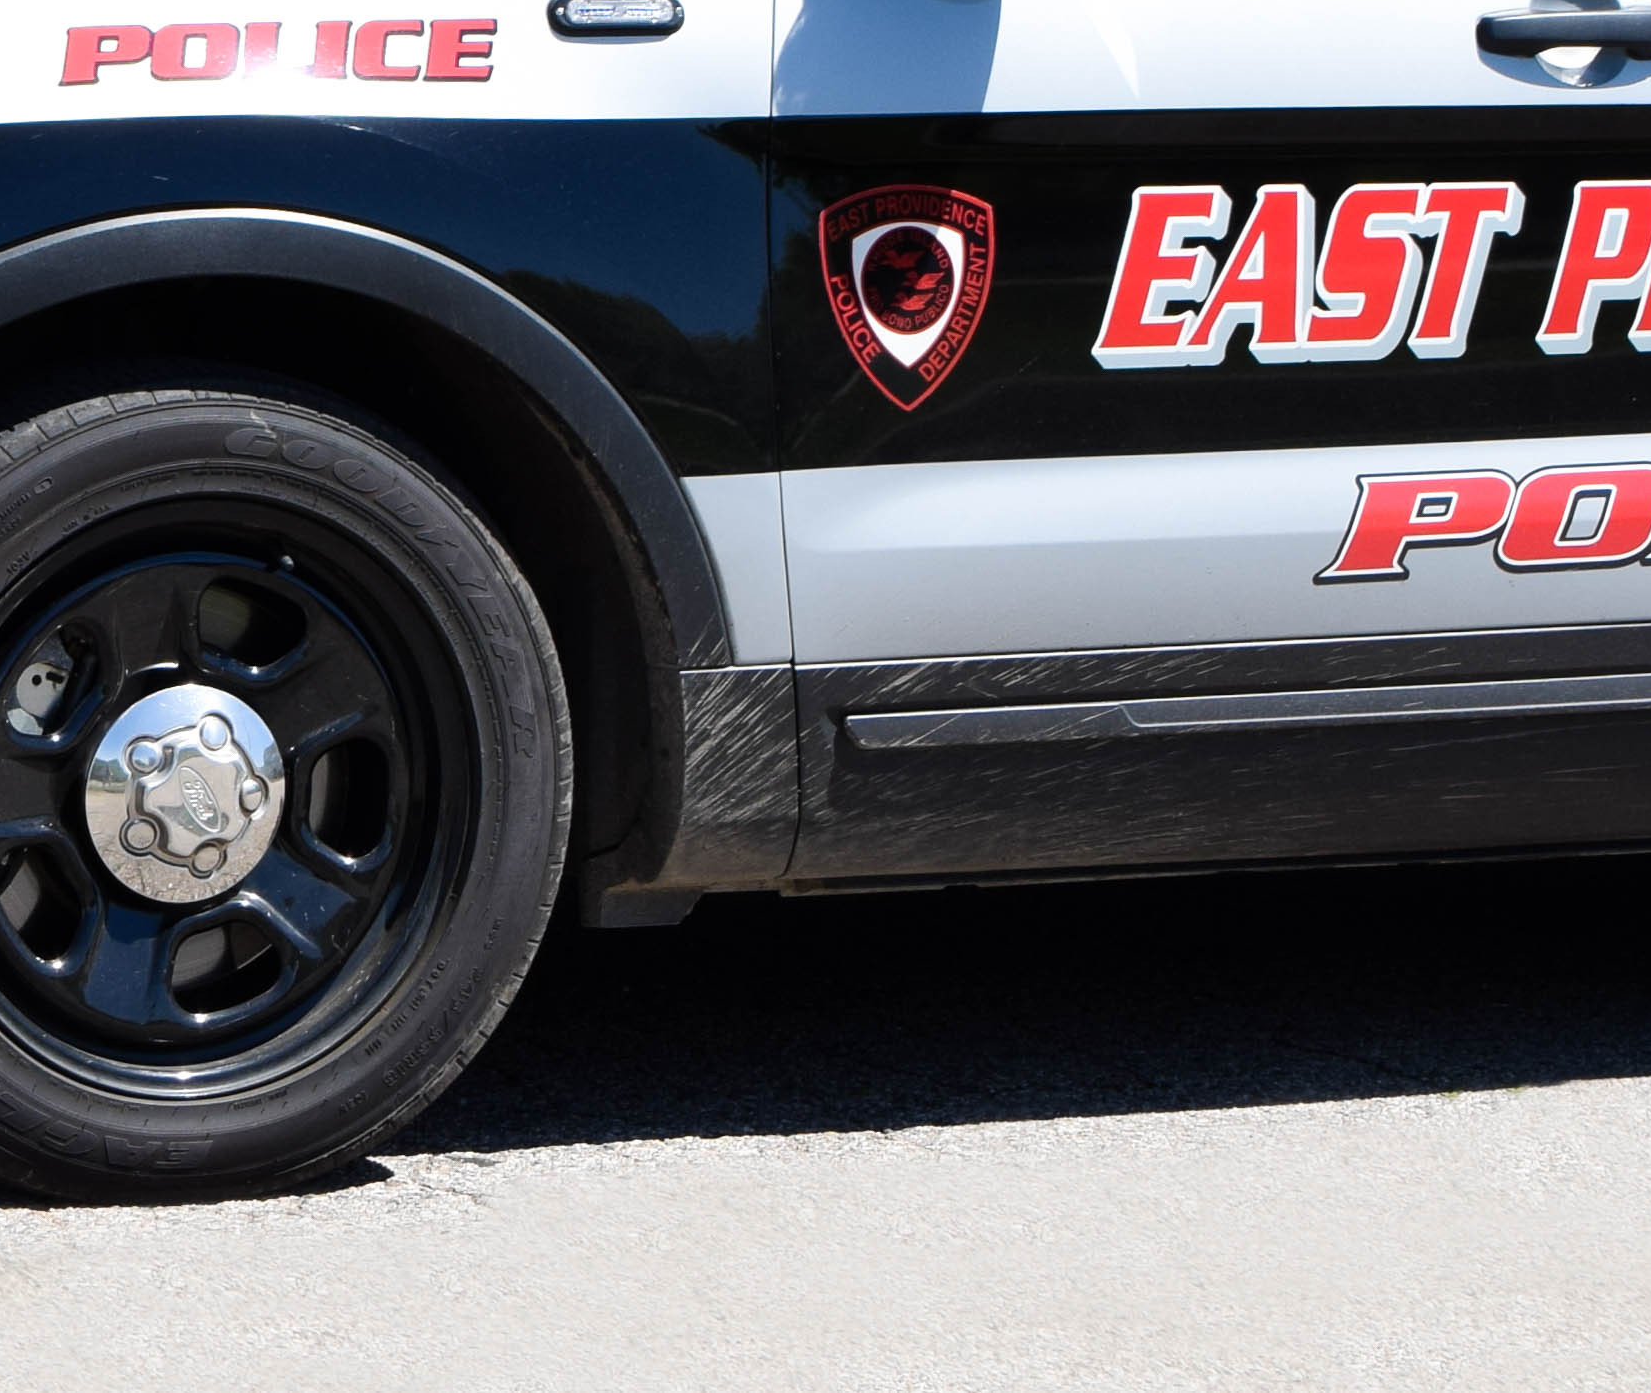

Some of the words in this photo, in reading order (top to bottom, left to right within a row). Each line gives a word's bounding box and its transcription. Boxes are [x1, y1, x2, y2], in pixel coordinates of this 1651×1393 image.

[828, 202, 869, 243] EAST
[875, 193, 986, 237] PROVIDENCE
[1092, 181, 1525, 369] EAST
[830, 272, 882, 365] POLICE
[918, 243, 987, 383] DEPARTMENT
[224, 426, 537, 760] GOODYEAR
